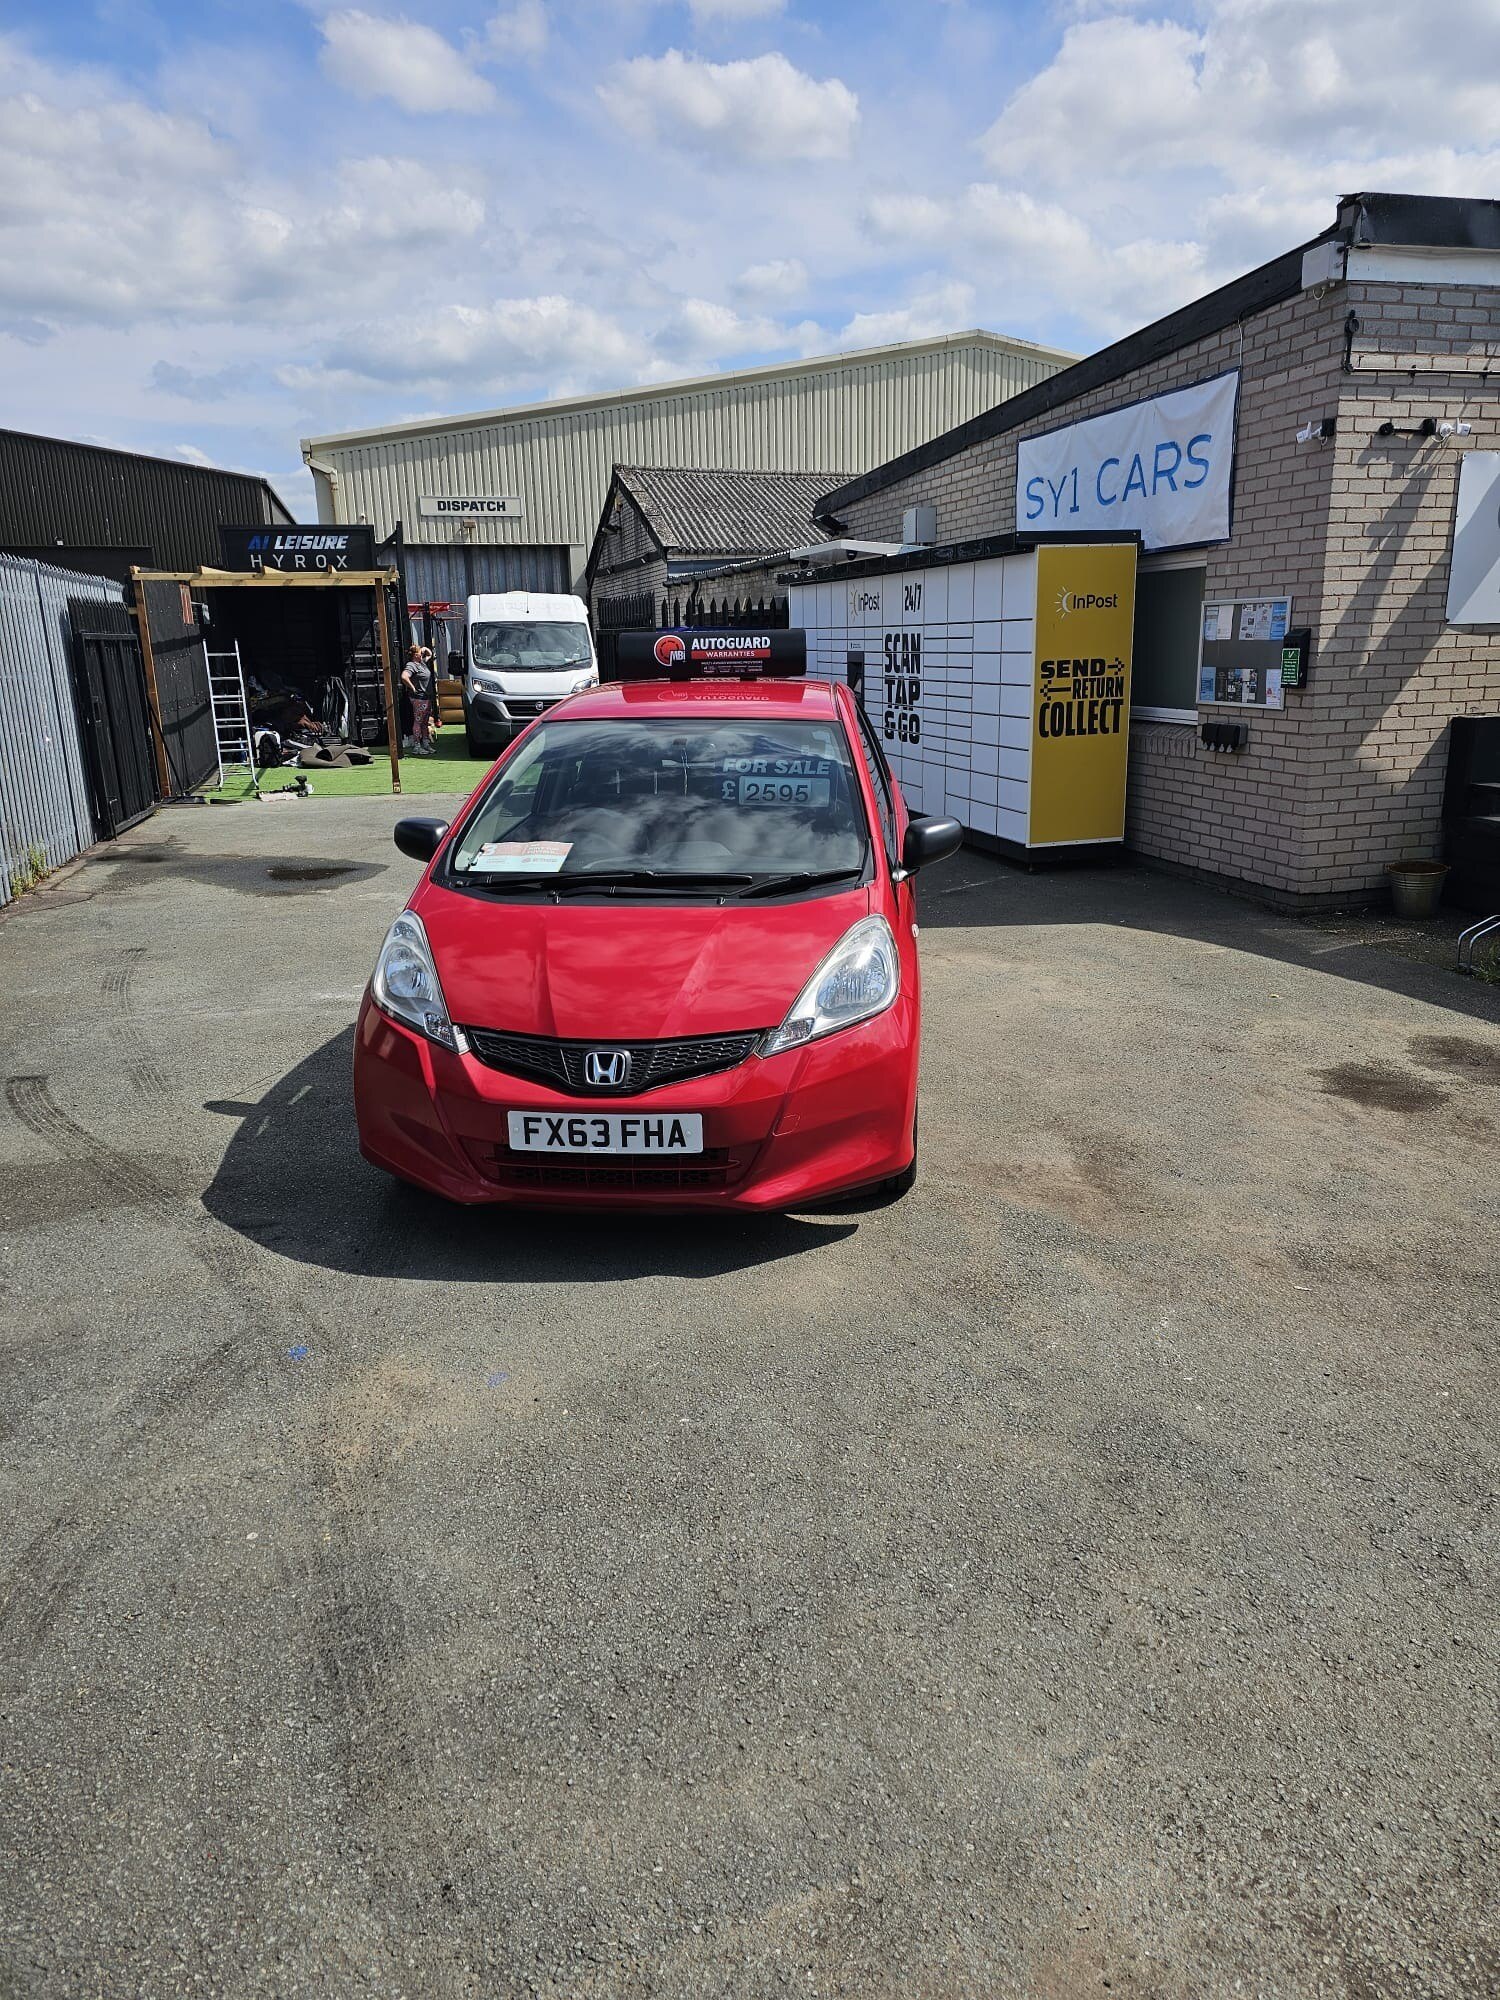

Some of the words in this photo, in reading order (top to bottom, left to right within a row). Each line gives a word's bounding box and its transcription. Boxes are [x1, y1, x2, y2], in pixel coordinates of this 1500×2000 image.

[1026, 467, 1079, 520] SY1
[1096, 434, 1212, 506] CARS
[437, 500, 507, 512] DISPATCH
[274, 535, 349, 550] LEISURE
[250, 554, 348, 568] HYROX
[858, 592, 880, 611] InPost
[904, 583, 922, 612] 24/7
[1073, 593, 1118, 609] InPost
[691, 636, 771, 650] AUTOGUARD
[705, 650, 755, 658] WARRANTIES
[884, 633, 921, 675] SCAN
[1040, 658, 1106, 679] SEND
[884, 675, 921, 711] TAP
[1072, 676, 1125, 699] RETURN
[1038, 699, 1124, 738] COLLECT
[722, 758, 768, 773] FOR
[774, 760, 832, 775] SALE
[722, 780, 736, 800] £
[746, 782, 809, 802] 2595
[523, 1116, 610, 1148] FX63
[620, 1119, 687, 1148] FHA
